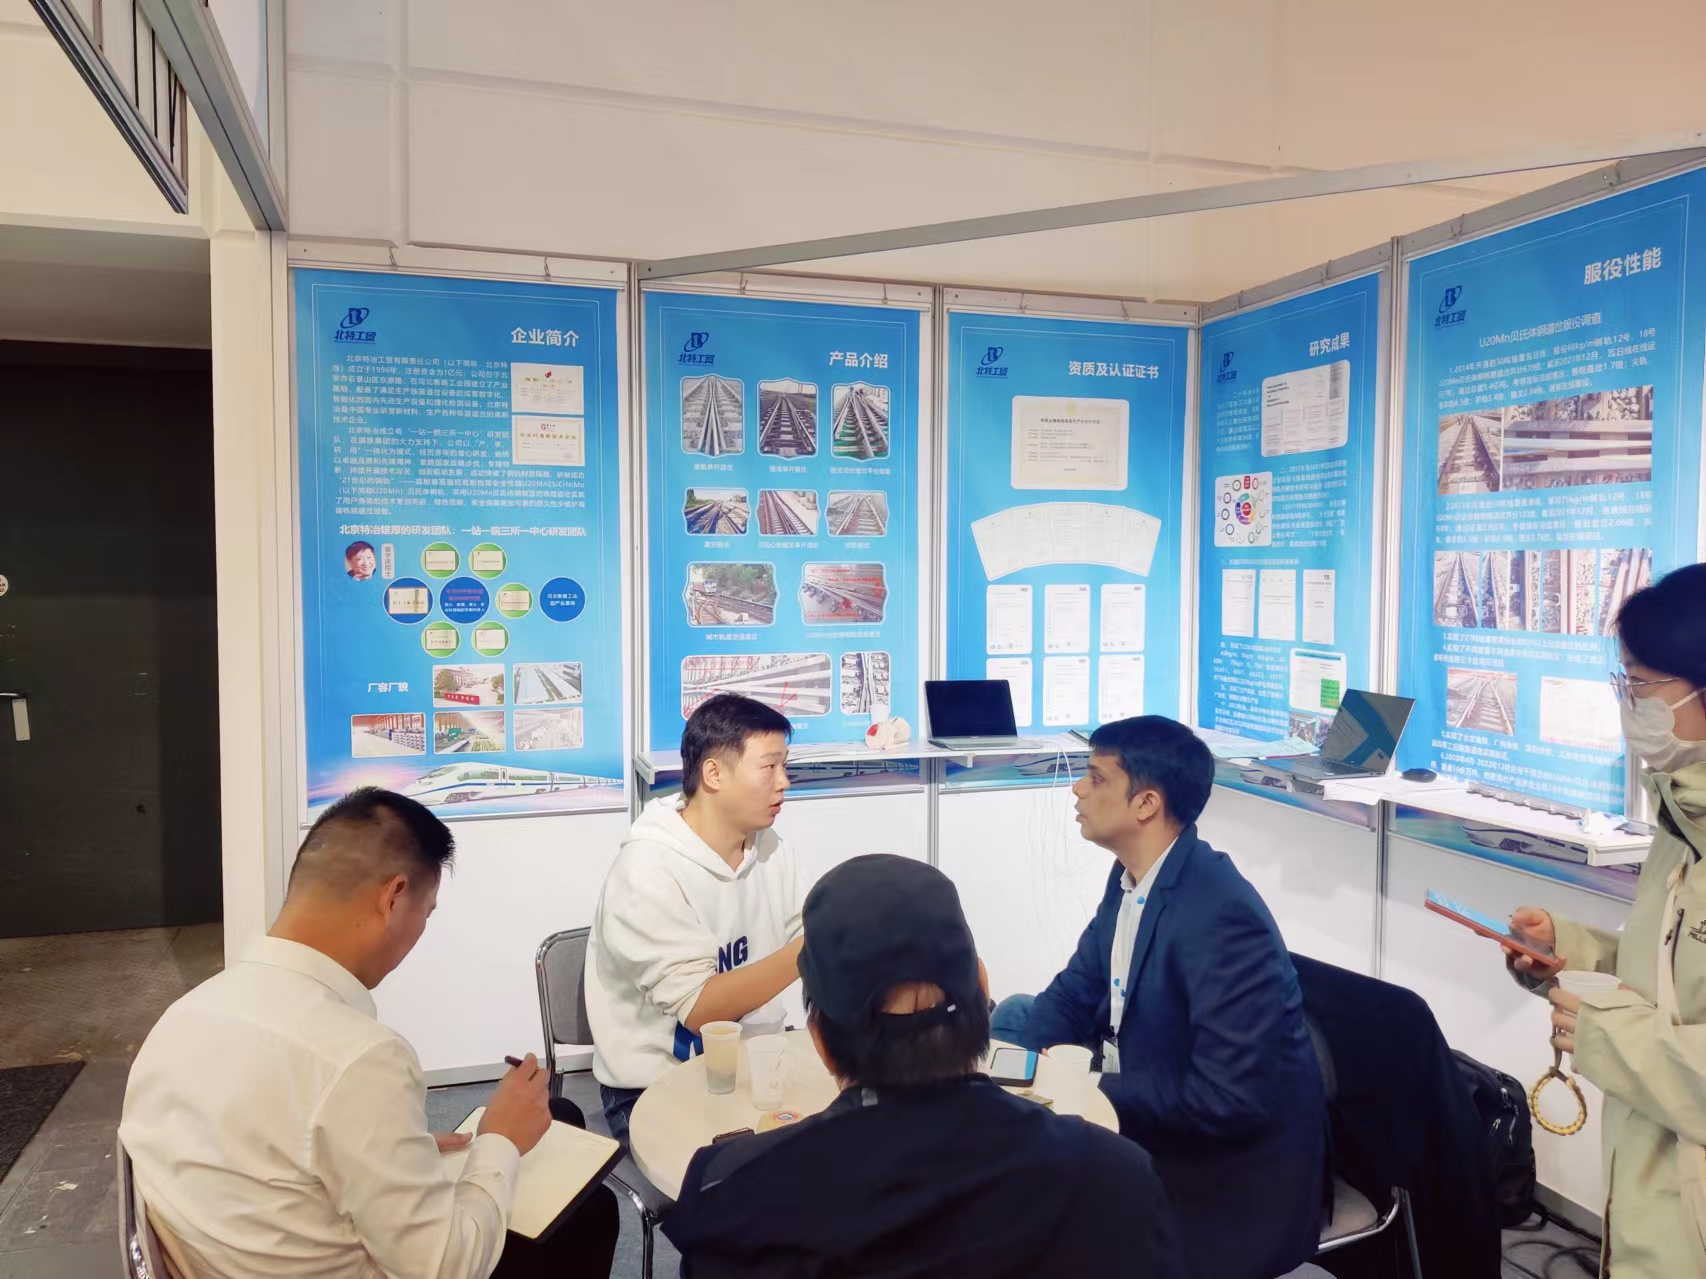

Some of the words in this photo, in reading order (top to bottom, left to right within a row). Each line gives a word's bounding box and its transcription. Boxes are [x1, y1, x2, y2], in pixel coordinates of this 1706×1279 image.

[1583, 246, 1662, 285] 服役性能
[333, 329, 377, 343] 北特工贸
[510, 327, 579, 347] 企业简介
[1309, 331, 1350, 357] 研究成果
[678, 353, 715, 365] 北特工贸
[829, 351, 888, 369] 产品介绍
[976, 366, 1008, 377] 北特工贸
[1068, 361, 1160, 379] 资质及认证证书
[367, 682, 409, 693] 厂容厂貌
